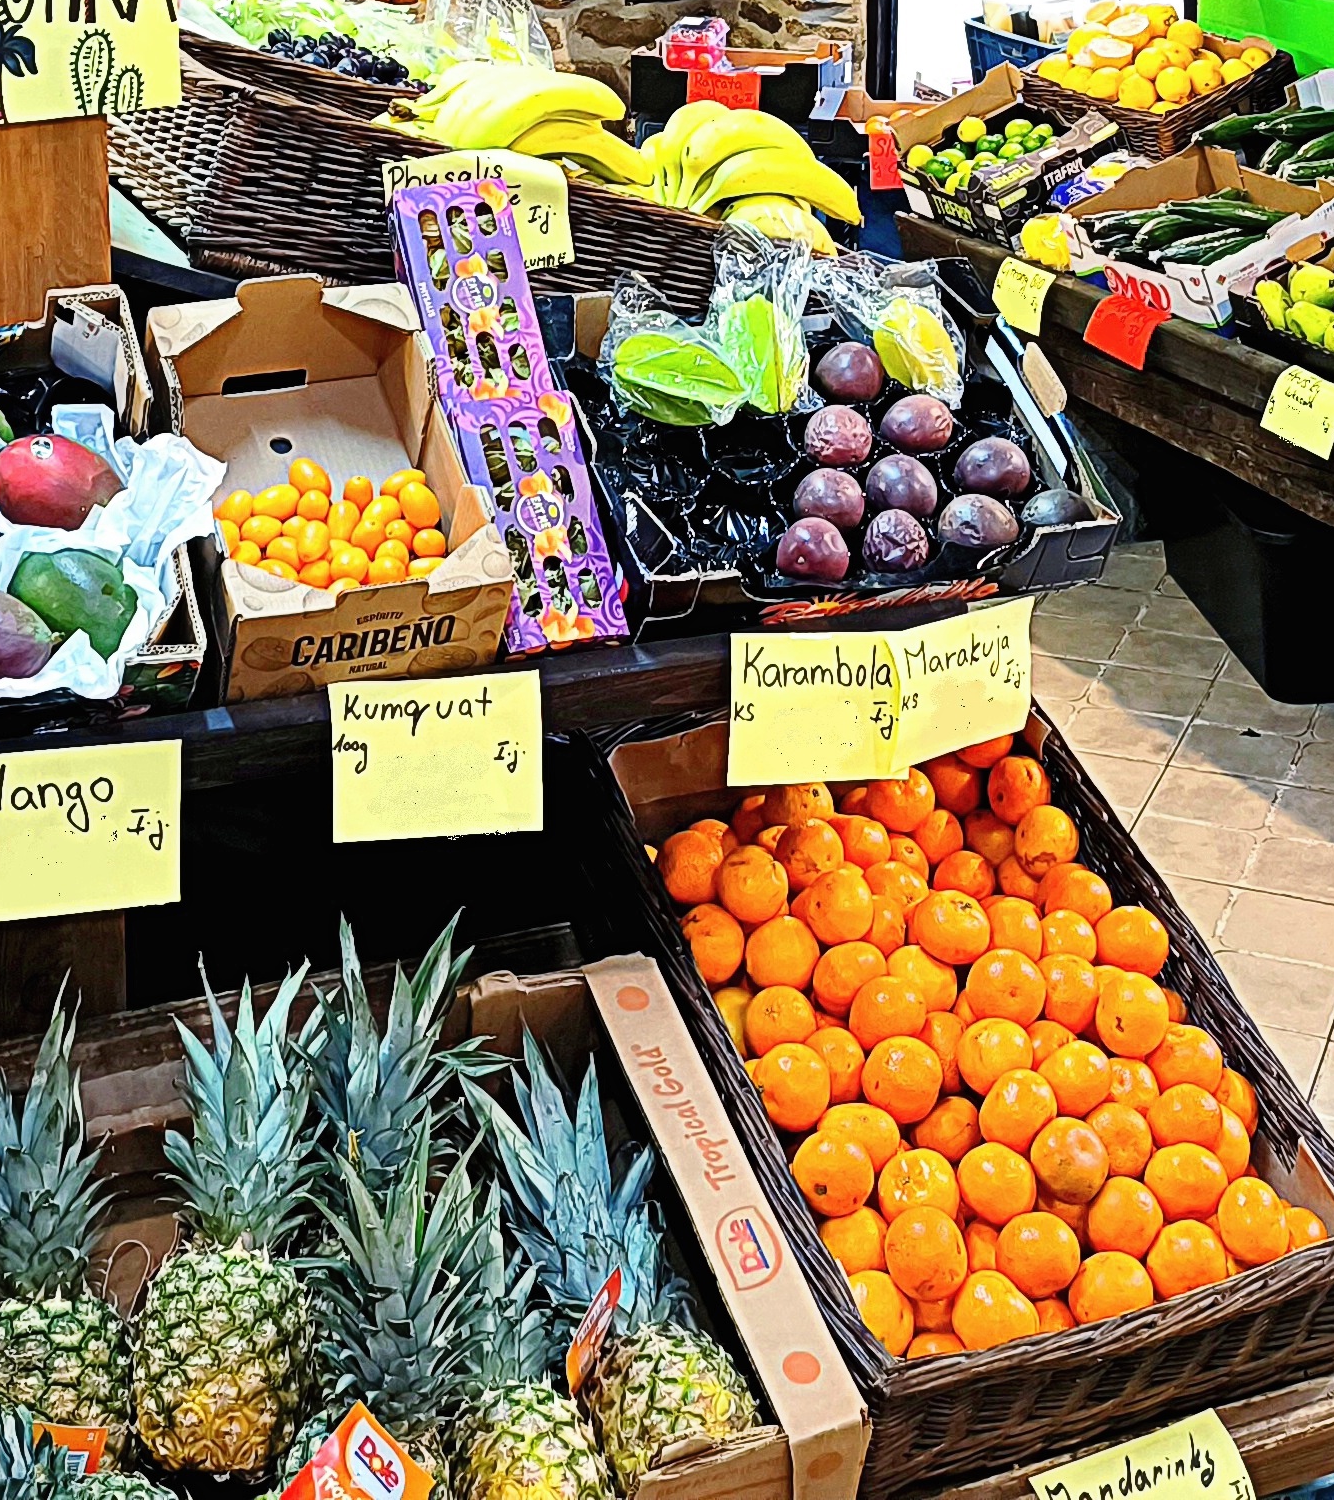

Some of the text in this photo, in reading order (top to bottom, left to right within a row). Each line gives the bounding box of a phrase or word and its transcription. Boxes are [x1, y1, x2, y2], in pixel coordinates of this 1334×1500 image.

[291, 615, 456, 667] CARIBEÑO
[744, 642, 893, 690] Karambola
[904, 625, 1010, 678] Marakuja
[349, 660, 387, 675] NATURAL
[344, 687, 493, 736] Kumquat
[638, 1046, 736, 1192] Tropical Gold
[729, 1219, 766, 1274] Dole
[357, 1435, 400, 1488] Dole
